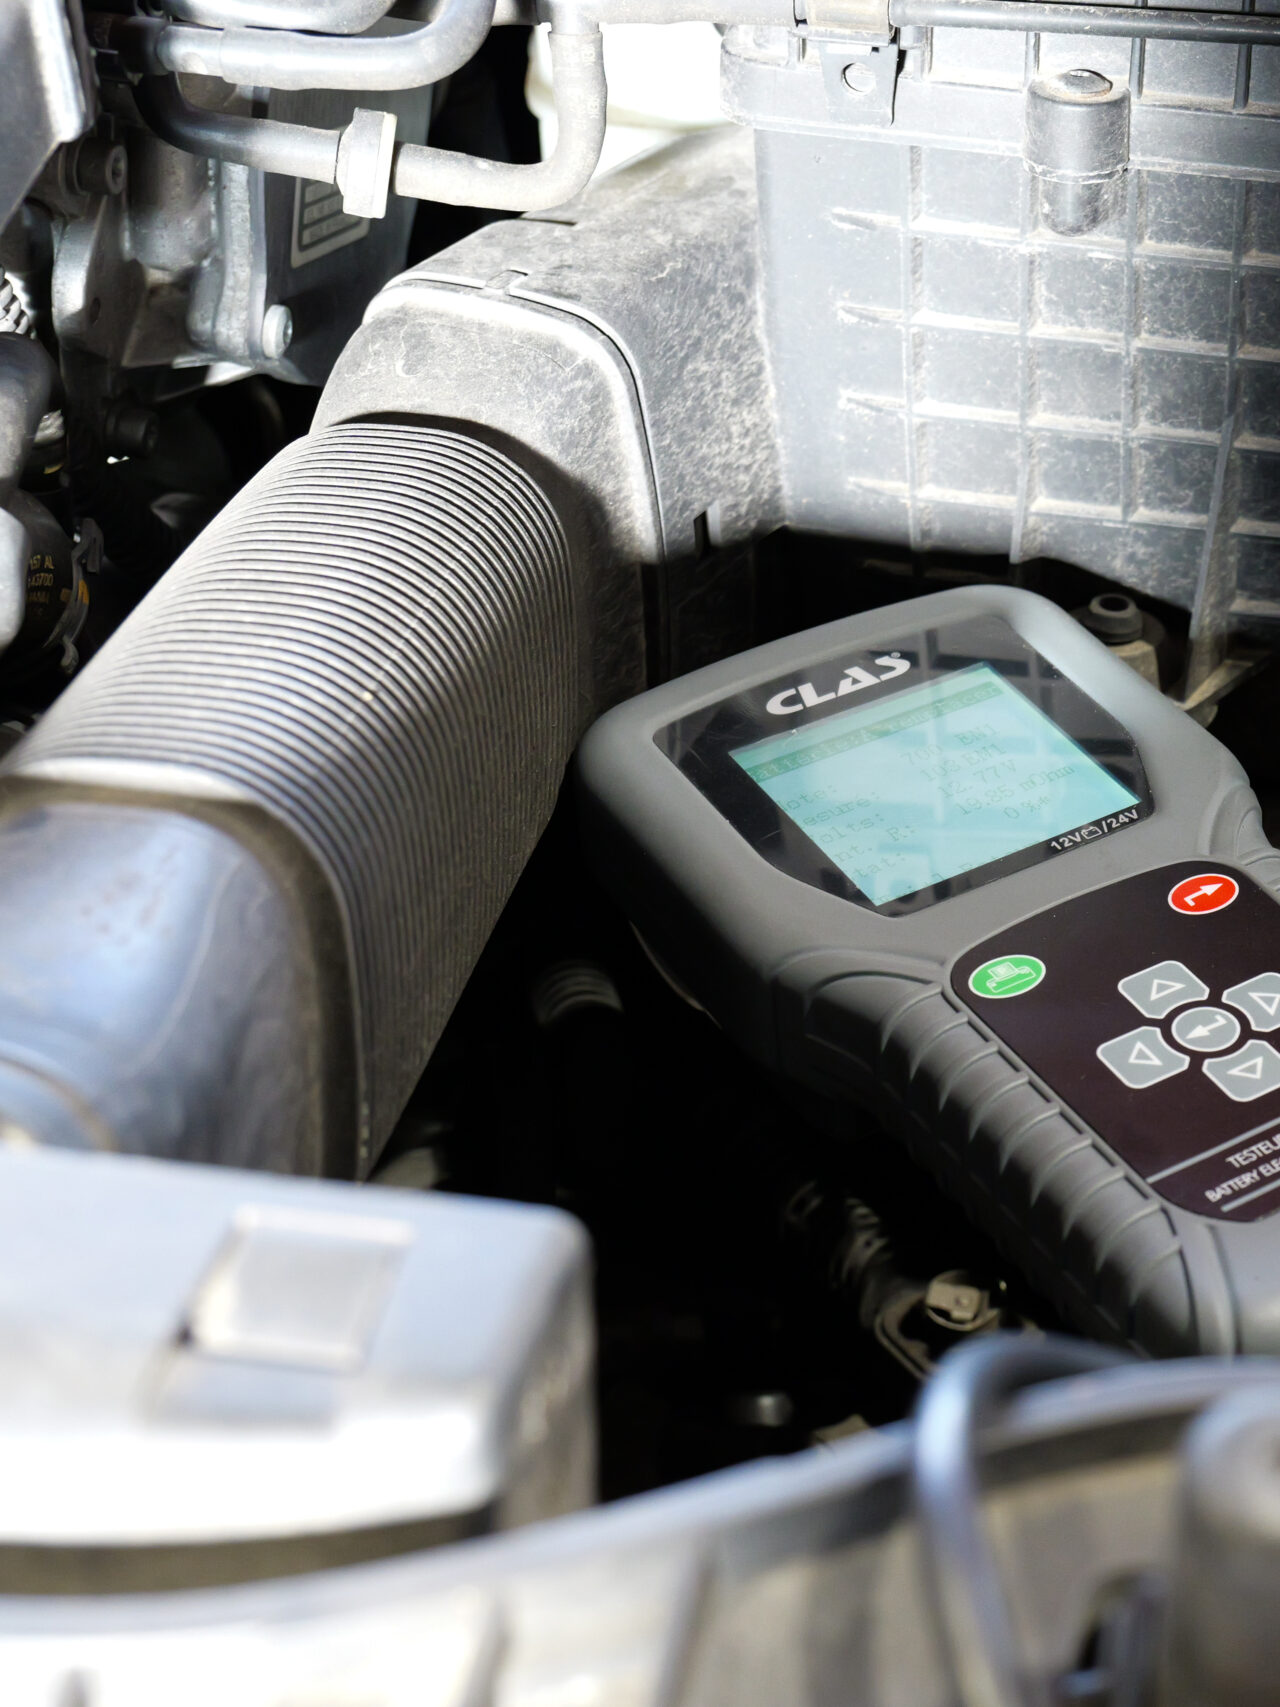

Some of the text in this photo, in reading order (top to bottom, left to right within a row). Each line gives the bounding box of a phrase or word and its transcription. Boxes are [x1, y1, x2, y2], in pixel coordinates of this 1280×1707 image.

[765, 653, 911, 716] CLAS
[1050, 834, 1081, 852] 12V
[1204, 1170, 1261, 1203] BATTERY
